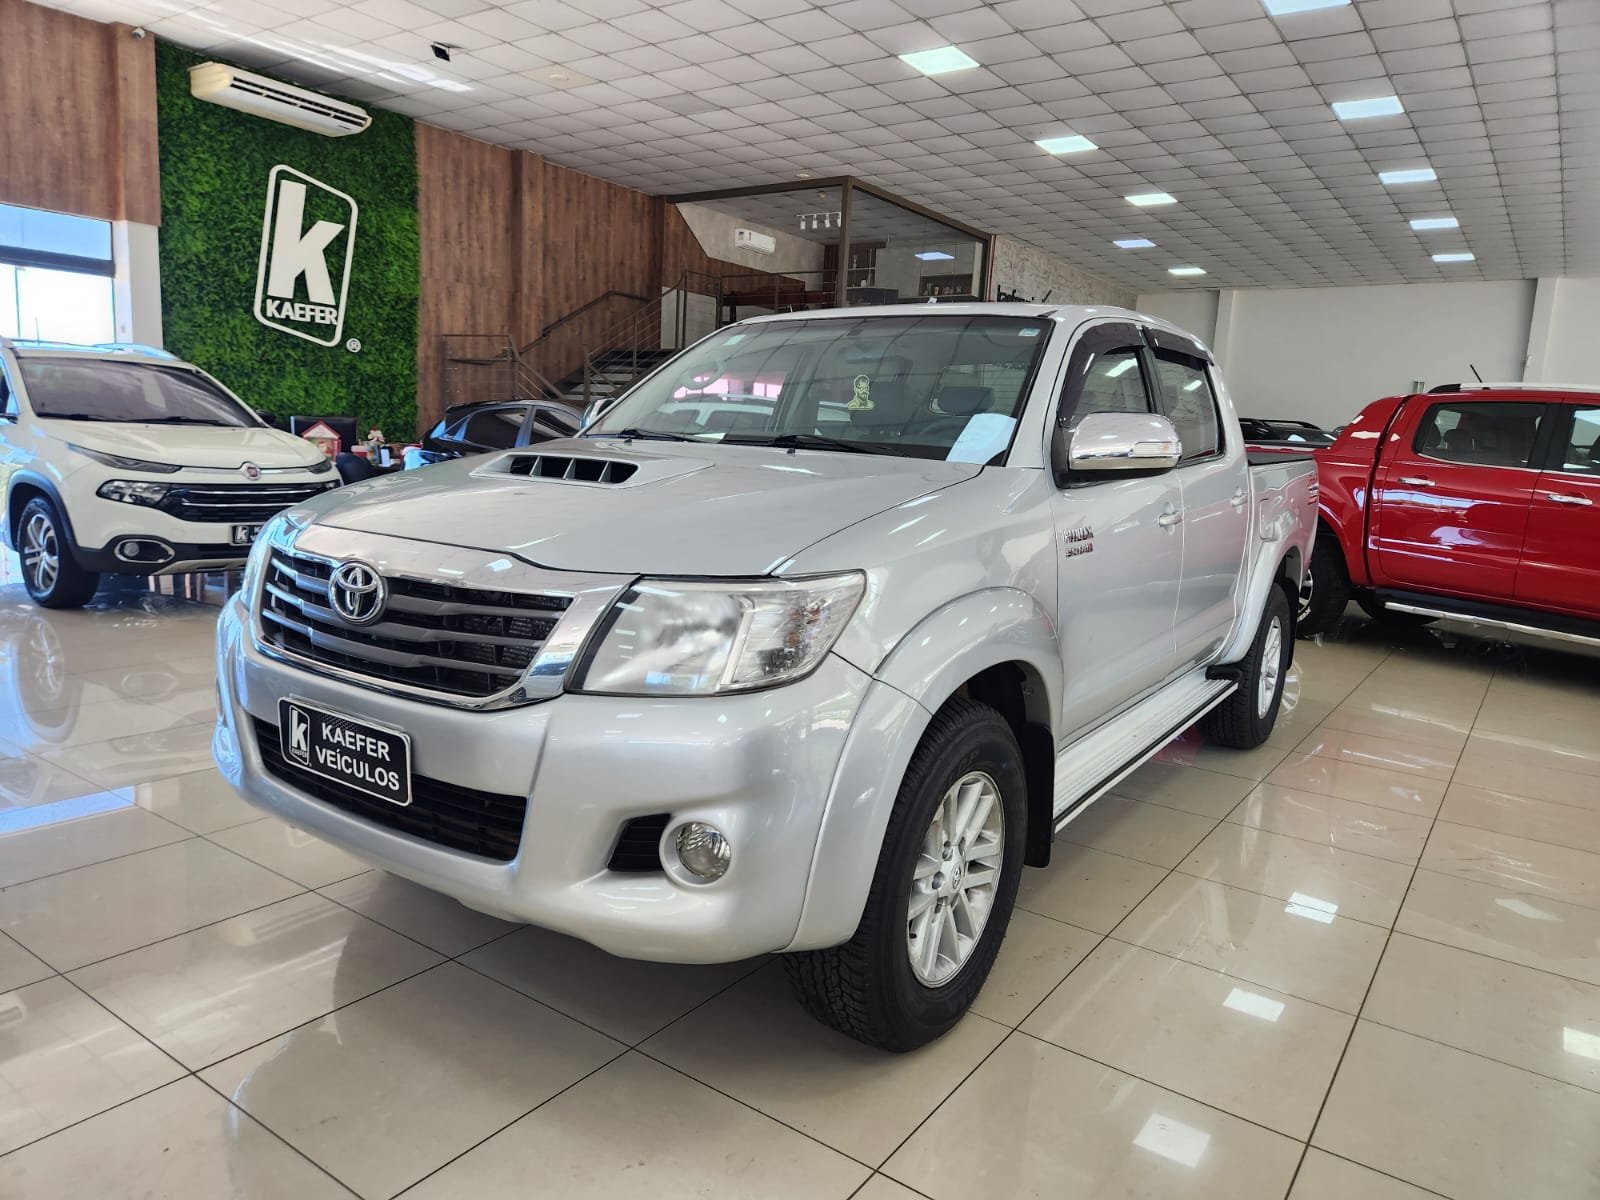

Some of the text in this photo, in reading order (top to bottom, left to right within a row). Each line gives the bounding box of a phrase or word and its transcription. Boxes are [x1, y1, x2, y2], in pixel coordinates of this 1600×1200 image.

[266, 299, 338, 325] KAEFER
[322, 723, 391, 761] KAEFER
[315, 745, 400, 791] VEÍCULOS
